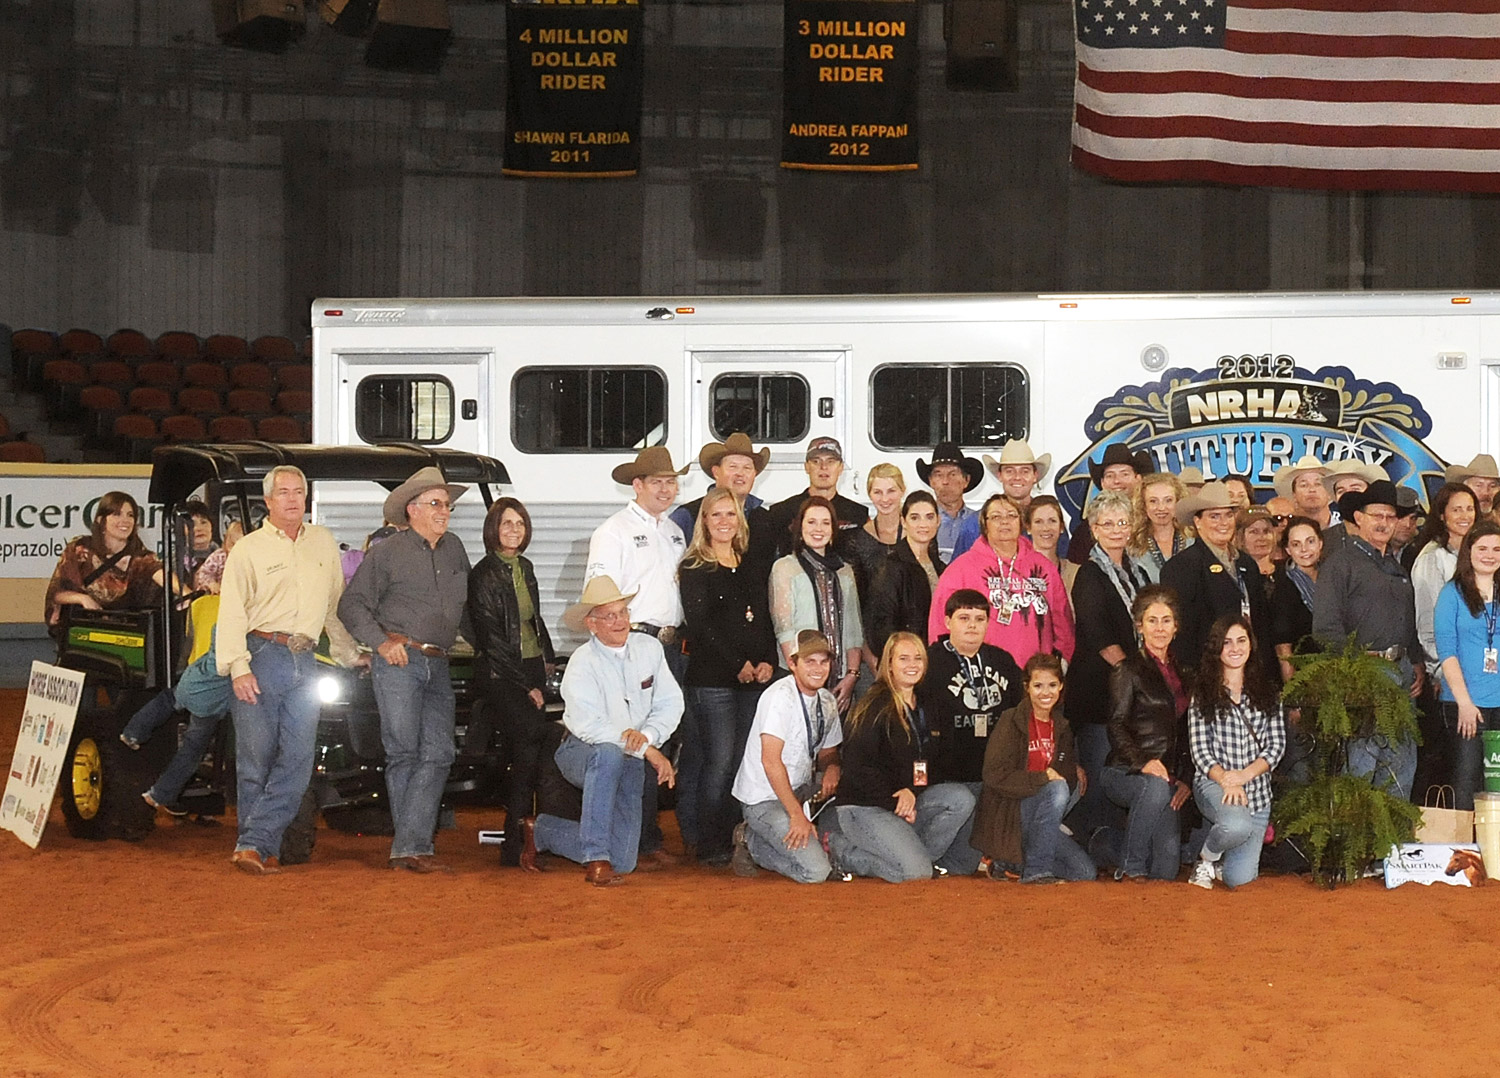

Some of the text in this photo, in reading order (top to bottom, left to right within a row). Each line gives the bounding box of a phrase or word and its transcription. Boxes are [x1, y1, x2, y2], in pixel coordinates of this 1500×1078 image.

[799, 20, 906, 37] 3 MILLION
[519, 29, 628, 44] 4 MILLION
[531, 52, 617, 67] DOLLAR
[809, 44, 894, 60] DOLLAR
[819, 67, 884, 82] RIDER
[540, 75, 606, 90] RIDER
[514, 131, 631, 145] SHAWN FLARIDA
[789, 123, 908, 138] ANDREA FAPPANI
[550, 150, 590, 163] 2011
[829, 143, 870, 156] 2012
[1217, 354, 1295, 381] 2012
[1187, 388, 1303, 424] NRHA
[1132, 432, 1392, 482] UTURITY
[947, 664, 1009, 697] AMRCAN
